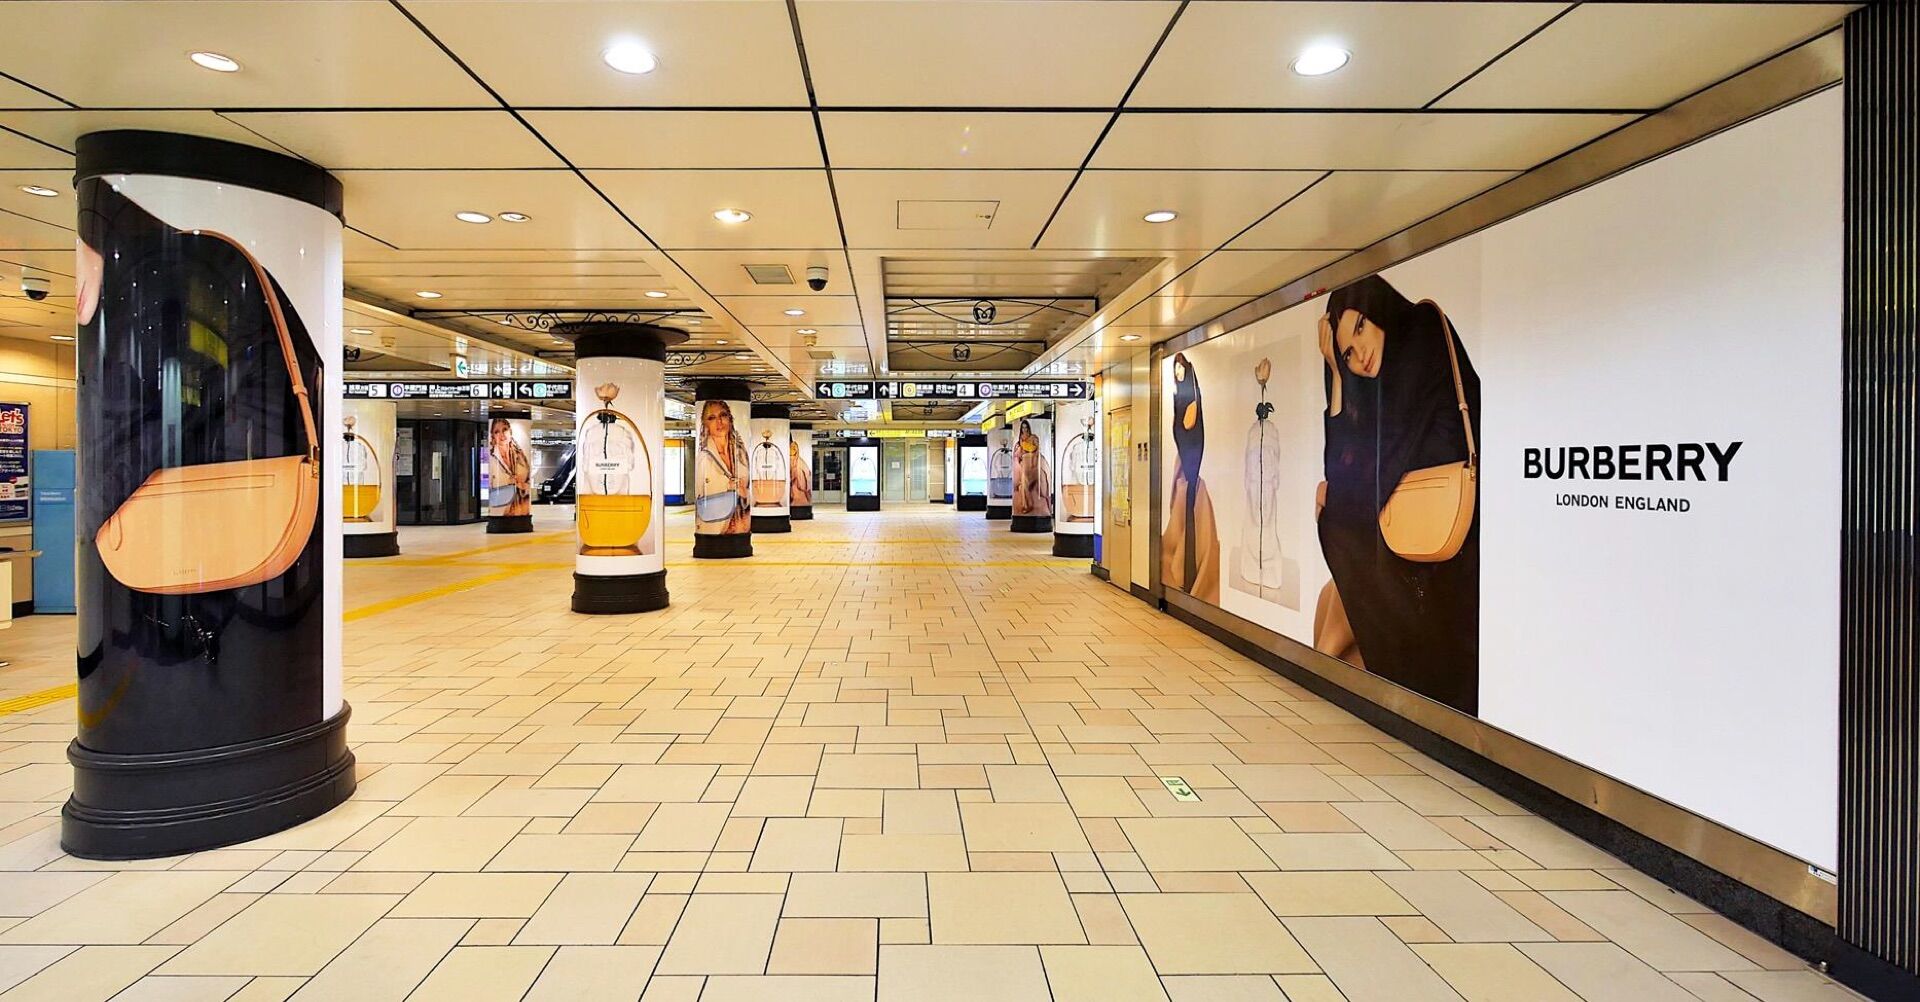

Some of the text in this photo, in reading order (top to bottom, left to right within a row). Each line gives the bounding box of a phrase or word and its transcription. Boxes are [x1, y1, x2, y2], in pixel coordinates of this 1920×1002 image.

[372, 385, 378, 396] 5
[473, 385, 479, 396] 6
[959, 385, 966, 395] 4
[1052, 384, 1059, 395] 3
[1524, 441, 1744, 482] BURBERRY
[1556, 493, 1691, 513] LONDON ENGLAND
